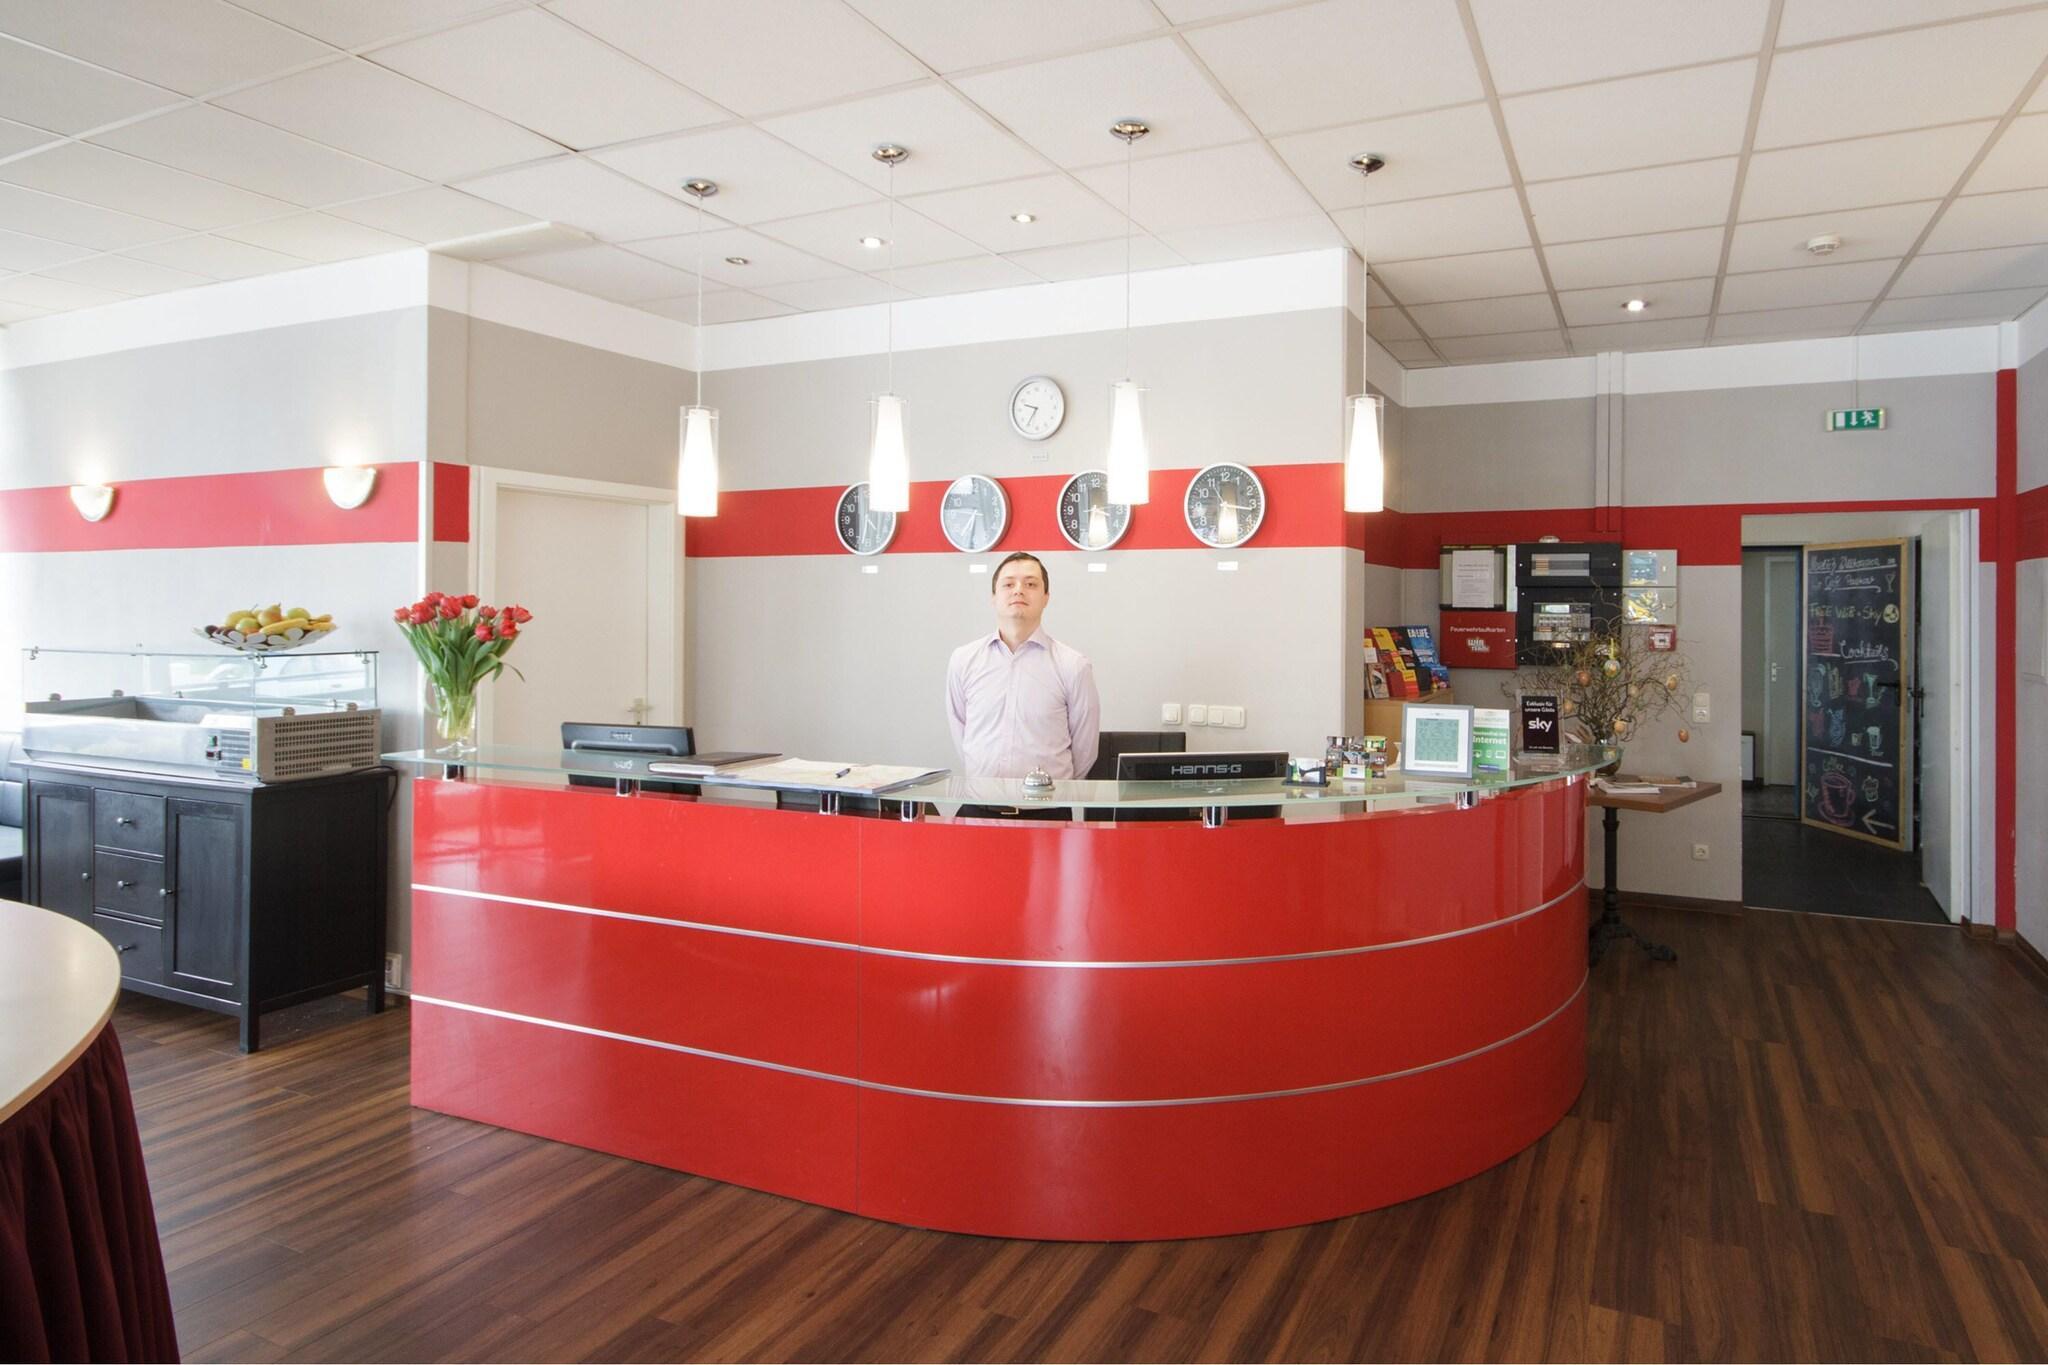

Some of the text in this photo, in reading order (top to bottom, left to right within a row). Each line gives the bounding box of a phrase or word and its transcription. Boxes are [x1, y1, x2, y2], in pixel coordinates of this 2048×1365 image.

[1220, 471, 1231, 482] 12
[1091, 478, 1101, 488] 12
[1207, 478, 1216, 488] 11
[1199, 487, 1209, 498] 10
[1246, 485, 1253, 496] 2
[1071, 493, 1081, 503] 10
[847, 503, 856, 513] 10
[1249, 499, 1257, 509] 3
[1067, 505, 1074, 515] 9
[1115, 504, 1123, 515] 3
[844, 515, 851, 525] 9
[1071, 520, 1078, 529] 8
[1200, 516, 1207, 526] 8
[848, 527, 855, 537] 8
[1840, 640, 1889, 660] Cocktails
[1528, 717, 1552, 732] sky
[1472, 735, 1506, 745] Internet
